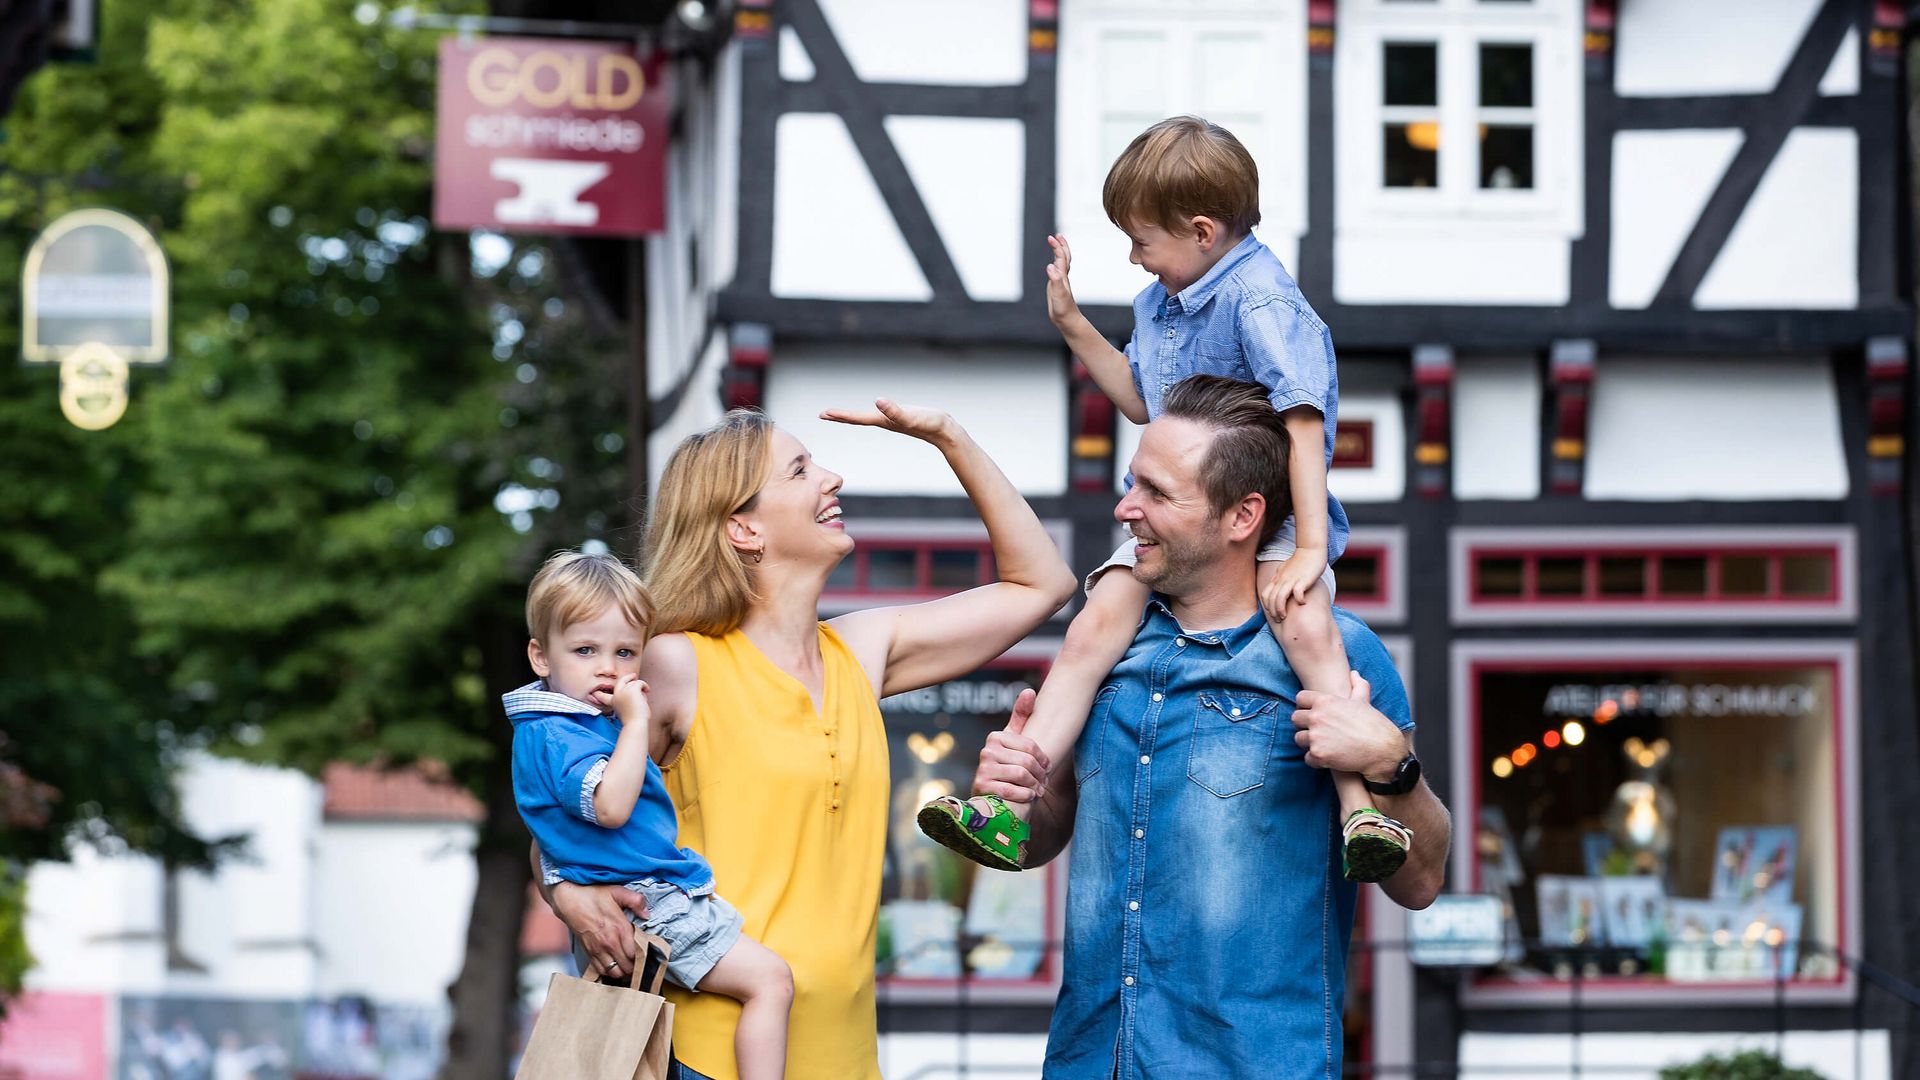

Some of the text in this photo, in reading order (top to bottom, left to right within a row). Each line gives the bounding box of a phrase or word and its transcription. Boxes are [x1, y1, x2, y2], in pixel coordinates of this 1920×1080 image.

[468, 50, 644, 110] GOLD
[465, 113, 645, 153] schmiede
[1691, 684, 1818, 717] SCHMUCK
[1412, 902, 1500, 939] OPEN
